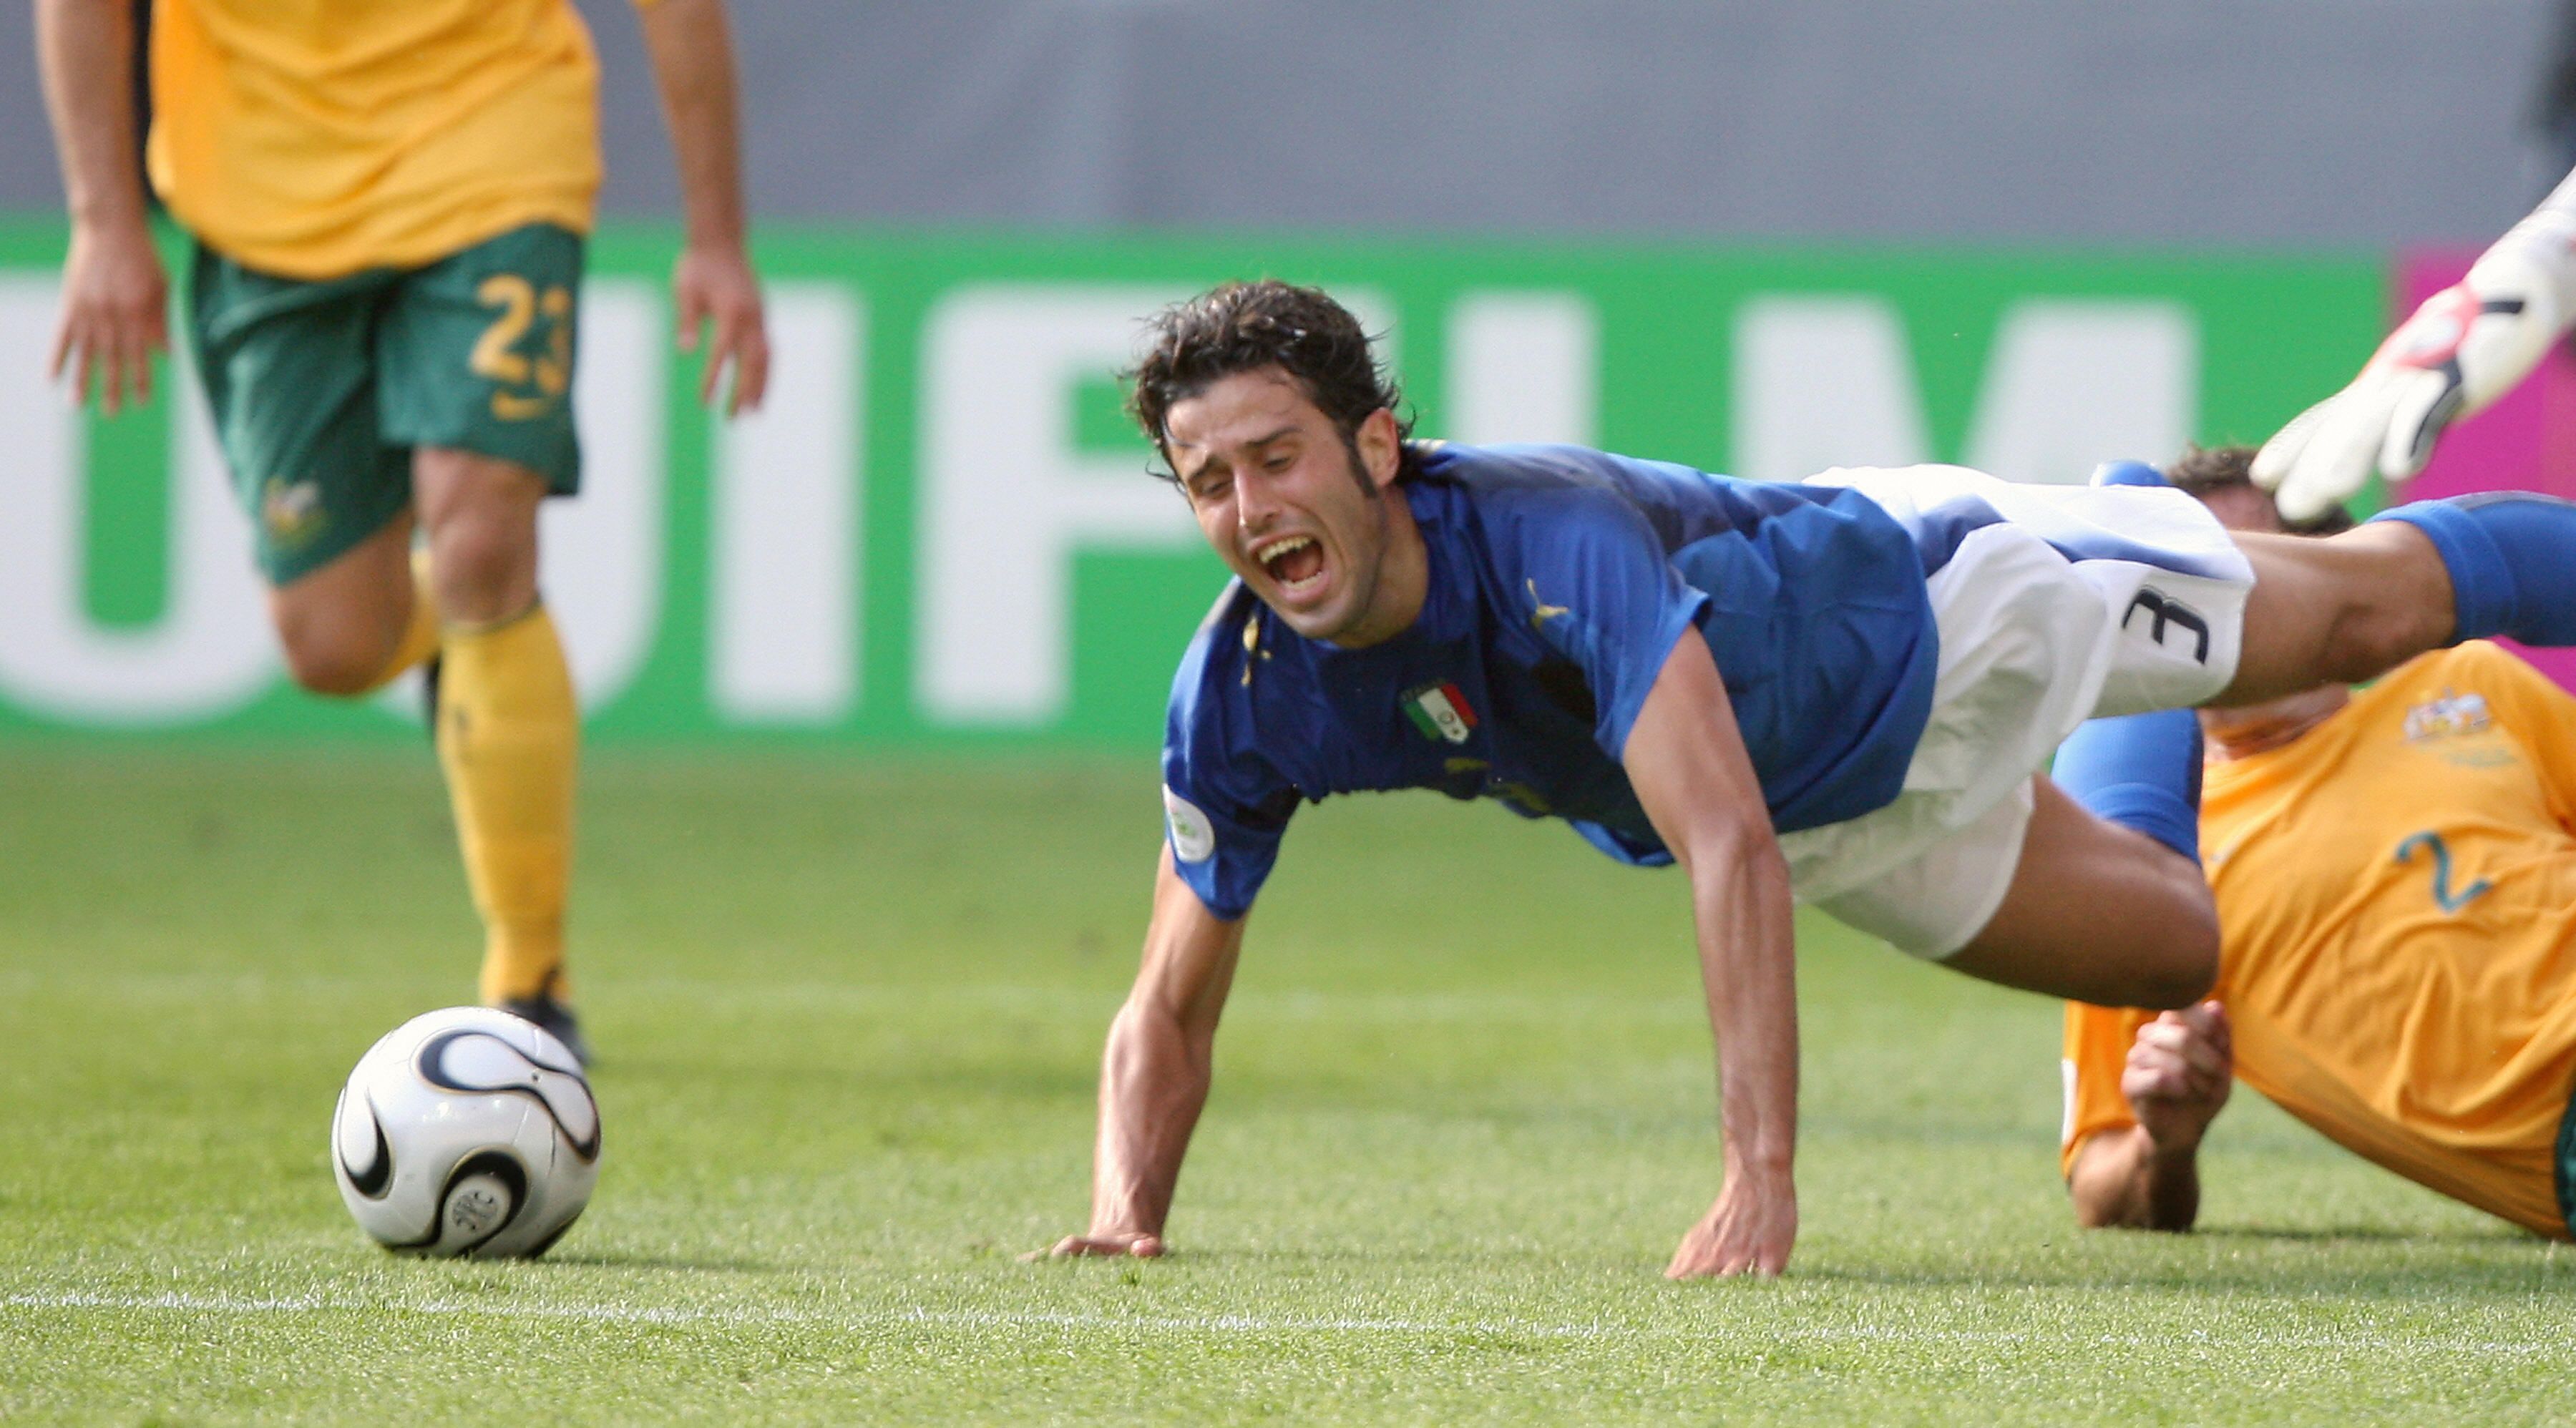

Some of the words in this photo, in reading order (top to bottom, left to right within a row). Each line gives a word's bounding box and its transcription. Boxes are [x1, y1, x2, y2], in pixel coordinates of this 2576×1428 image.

[469, 272, 571, 396] 23
[0, 272, 2198, 726] UJIF
[2121, 585, 2209, 667] 3
[2396, 830, 2492, 913] 2
